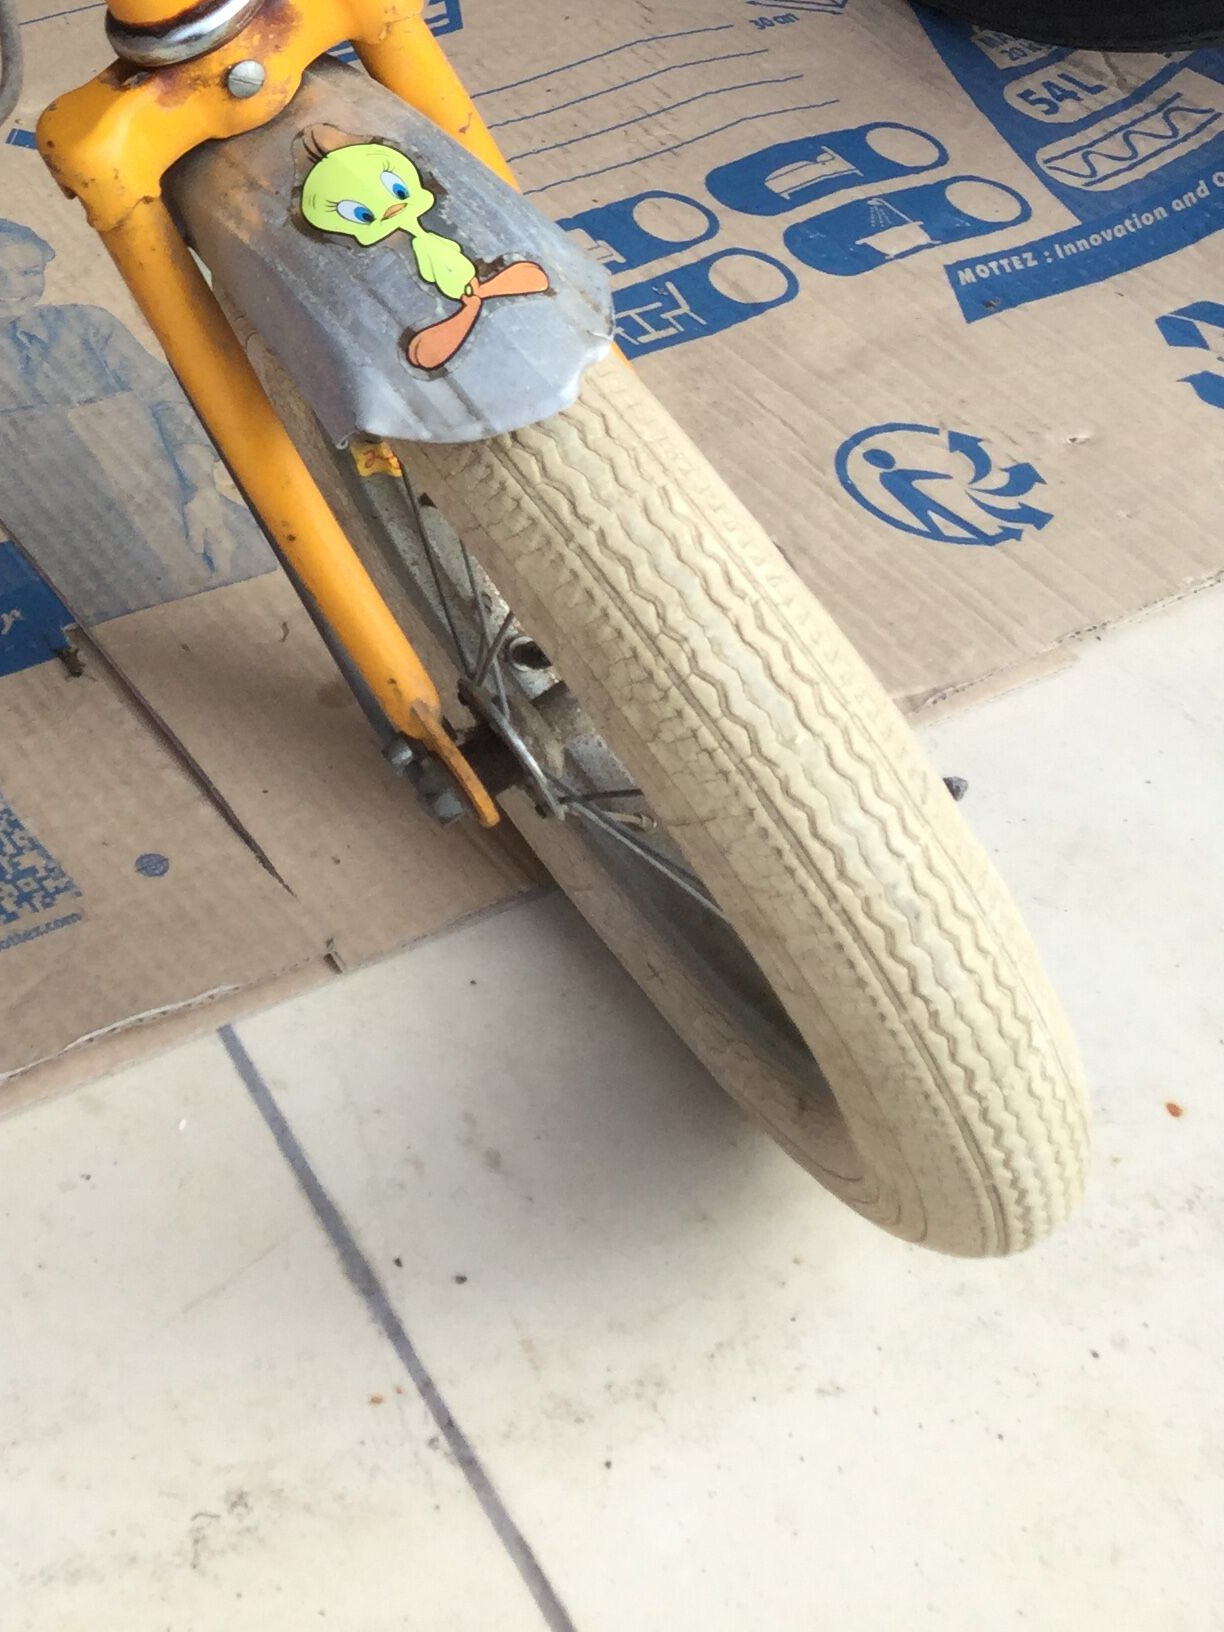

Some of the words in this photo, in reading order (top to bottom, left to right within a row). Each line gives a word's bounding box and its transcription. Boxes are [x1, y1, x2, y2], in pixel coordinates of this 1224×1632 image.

[749, 16, 775, 30] 30
[774, 12, 801, 25] cm
[957, 252, 1039, 286] MOTTEZ
[1055, 205, 1168, 260] Innovation
[1171, 180, 1210, 212] and
